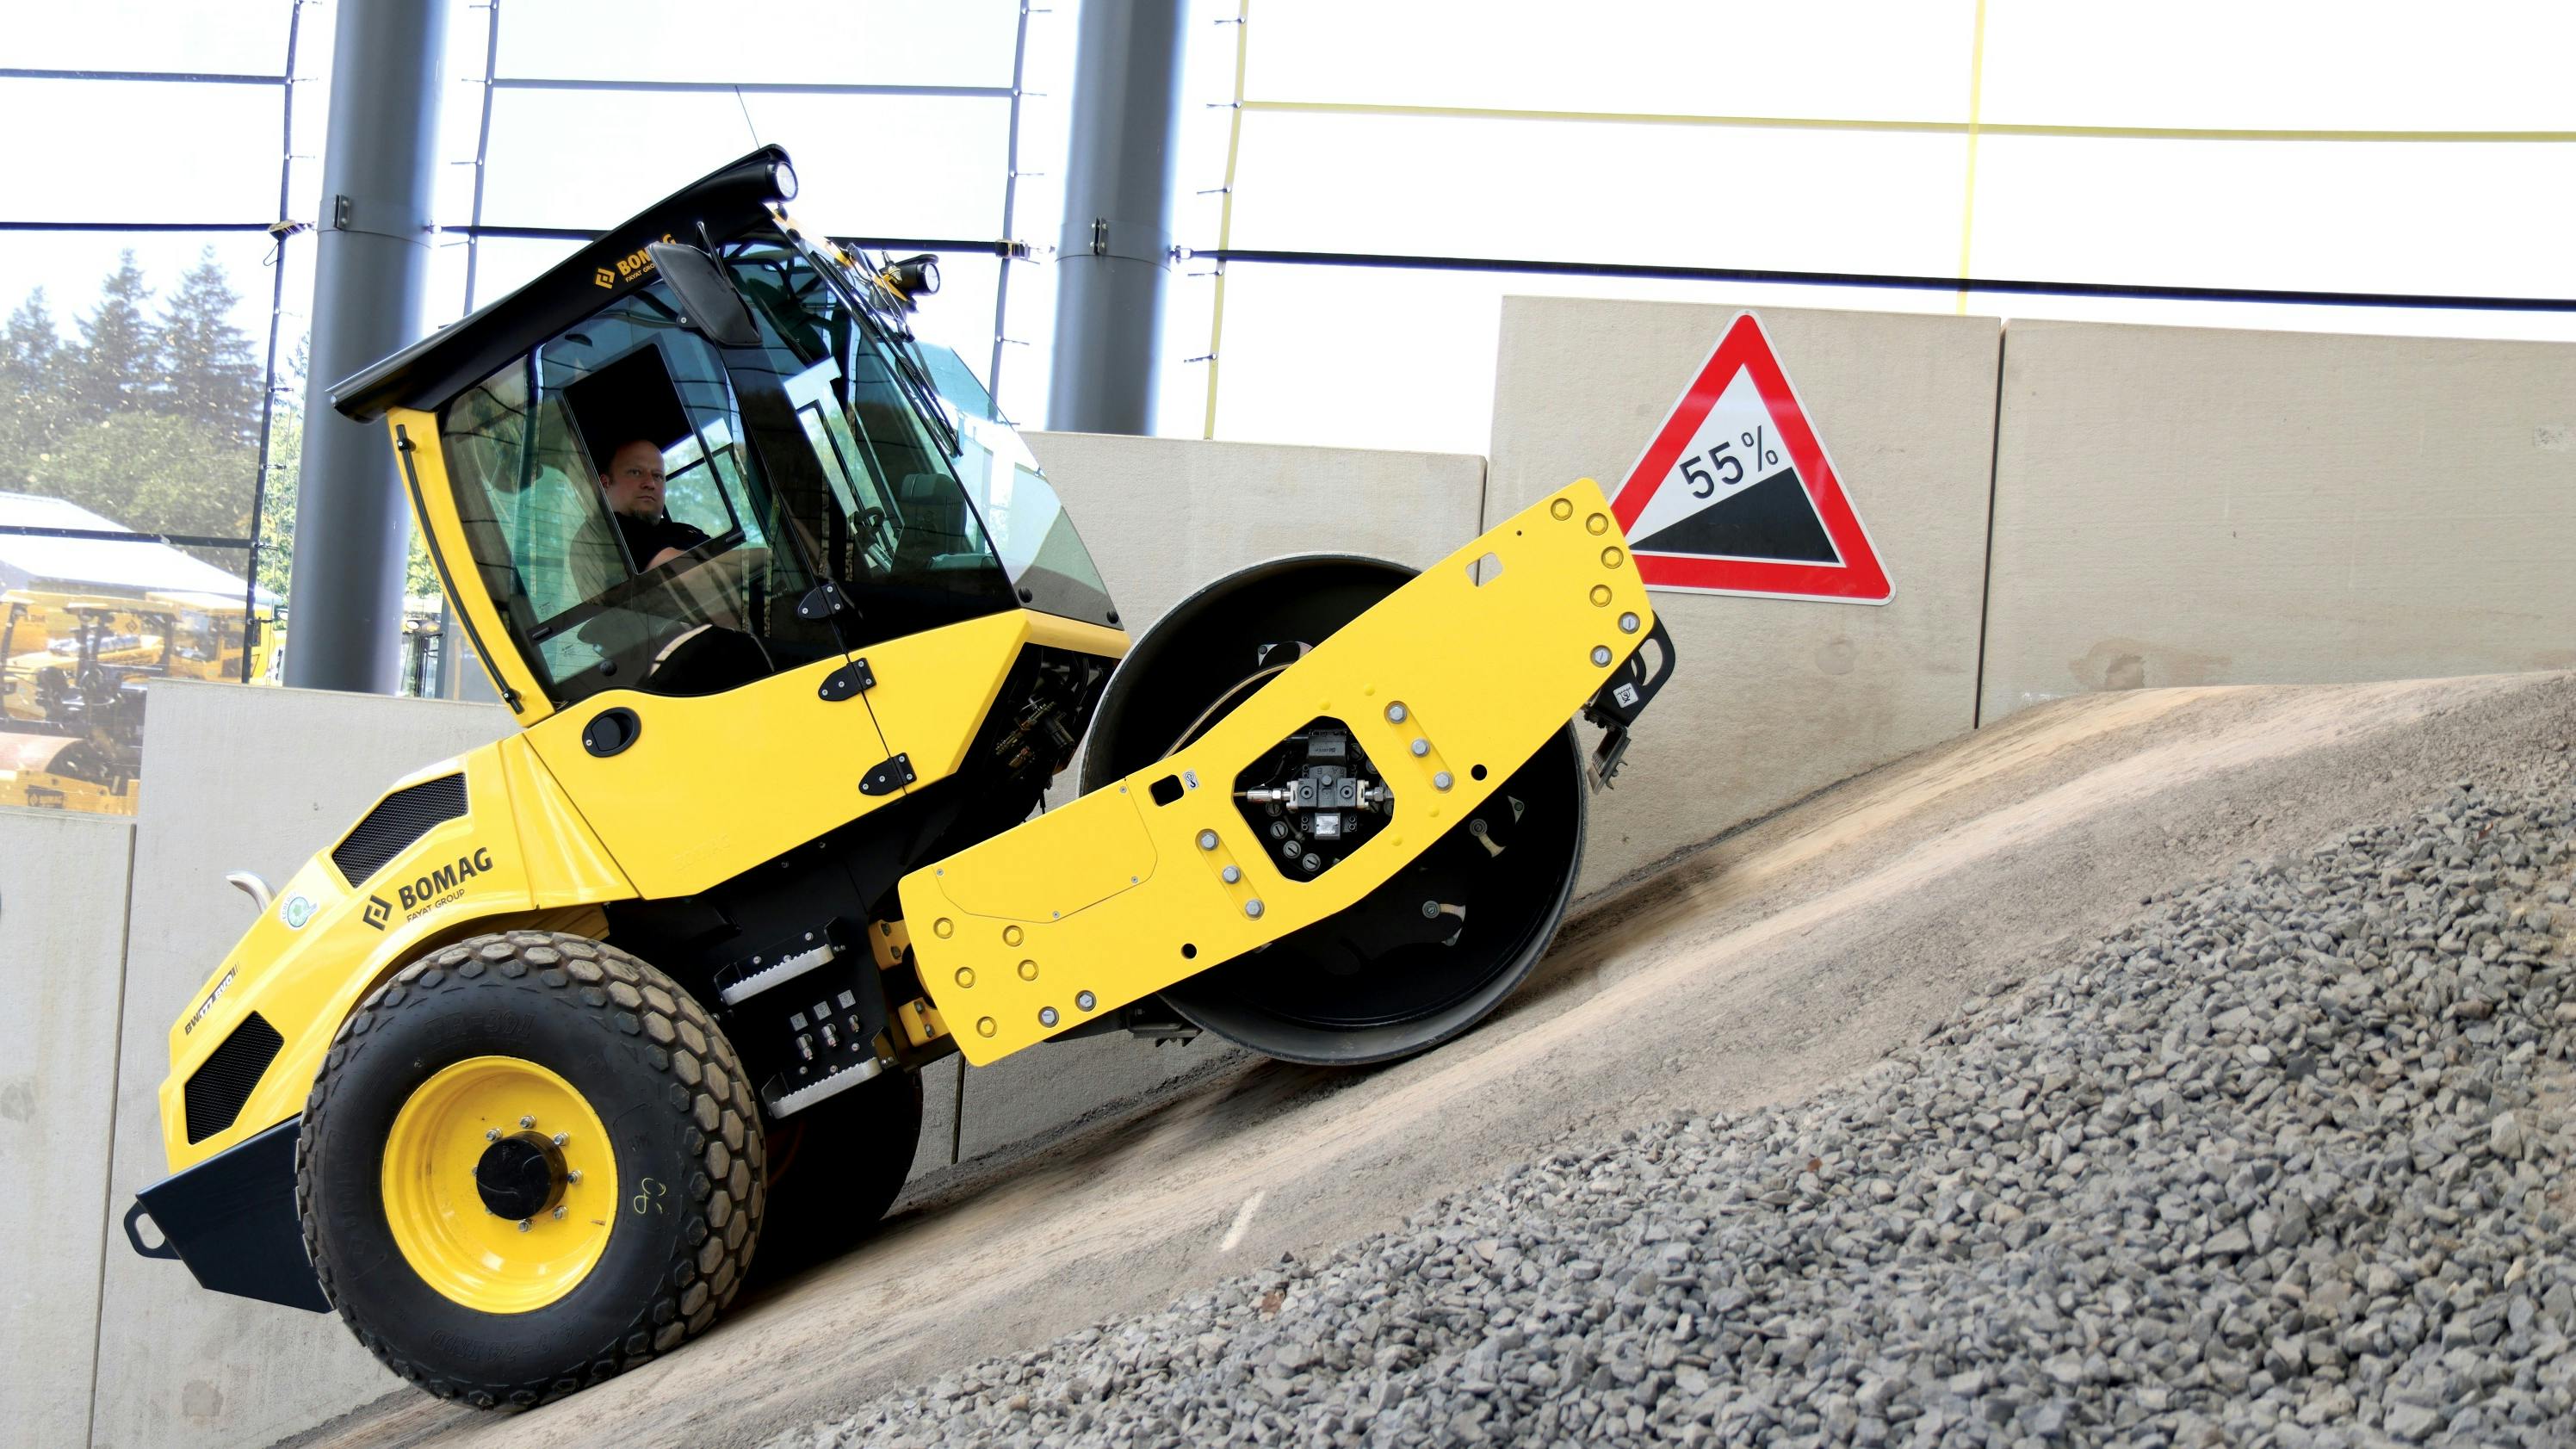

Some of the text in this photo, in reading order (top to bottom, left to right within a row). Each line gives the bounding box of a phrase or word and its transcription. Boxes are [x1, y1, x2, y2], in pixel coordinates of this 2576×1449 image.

[625, 270, 642, 282] FAYAT
[1679, 425, 1779, 499] 55%
[398, 846, 494, 911] BOMAG
[406, 889, 465, 923] FAYAT GROUP
